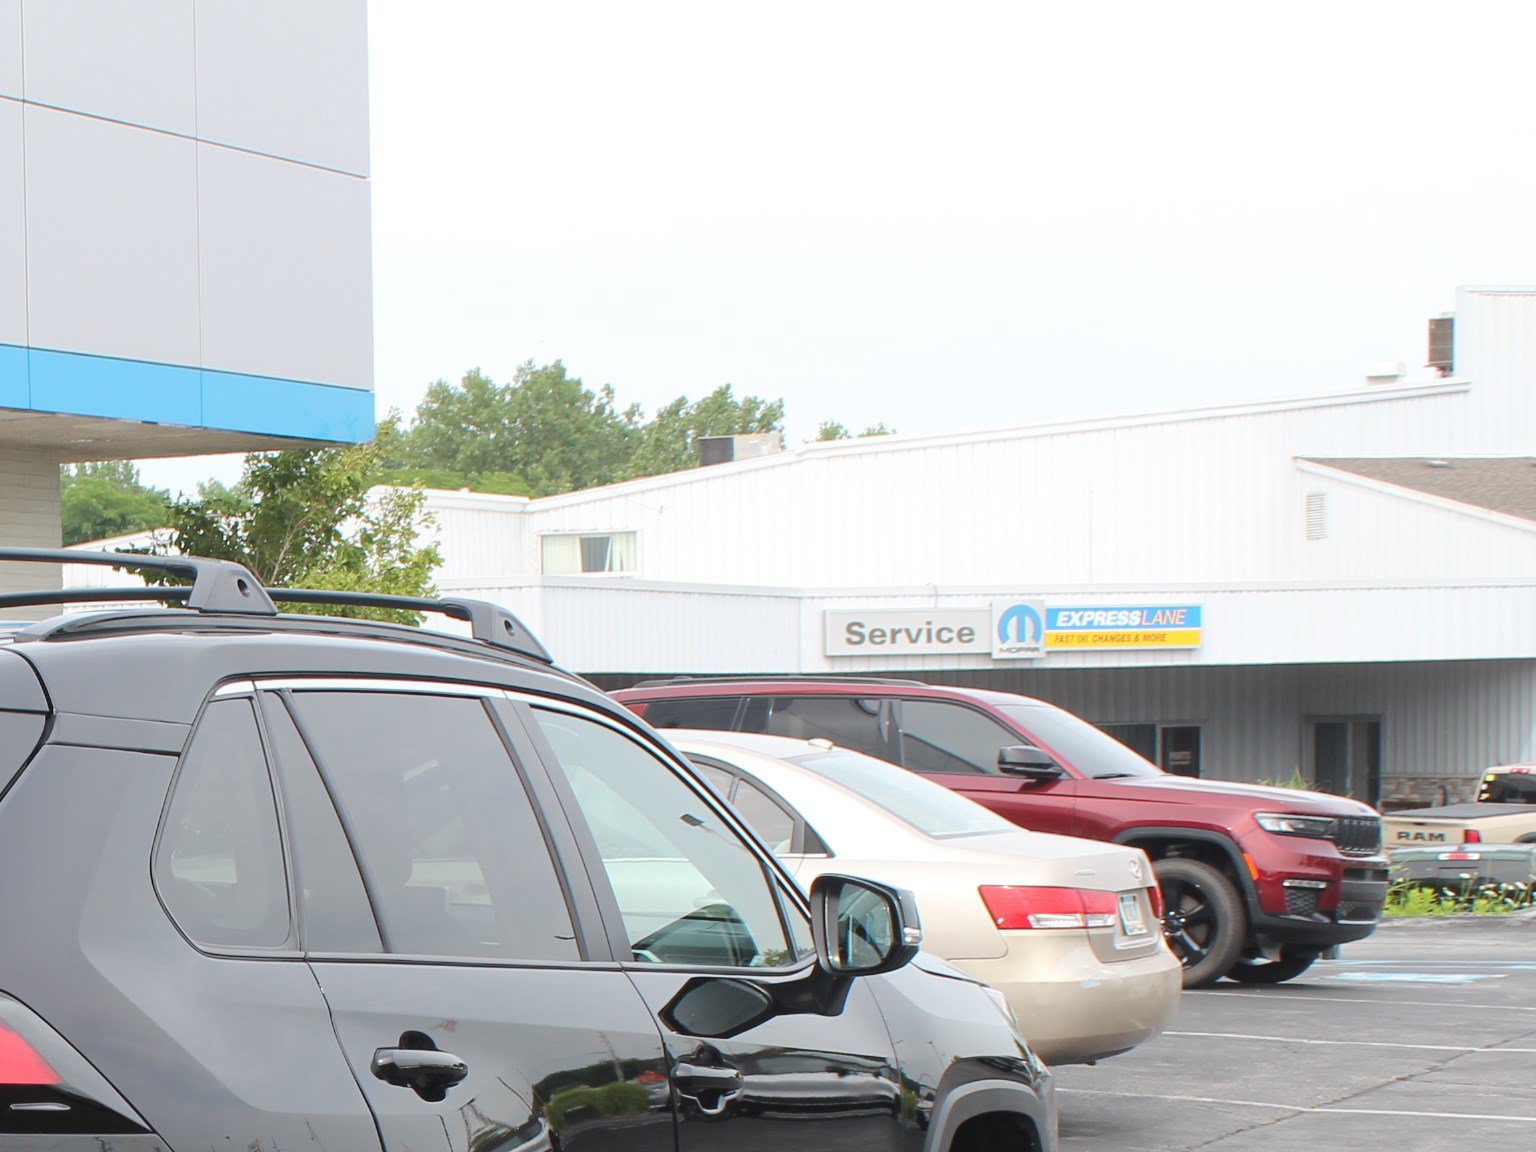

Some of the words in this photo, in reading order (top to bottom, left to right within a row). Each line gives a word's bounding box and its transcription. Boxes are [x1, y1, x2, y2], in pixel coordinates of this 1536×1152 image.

[844, 620, 975, 646] Service
[1054, 634, 1075, 644] FAST
[1077, 634, 1089, 644] OIL
[1093, 633, 1133, 643] CHANGES
[1142, 632, 1167, 642] MORE
[1396, 831, 1446, 842] RAM
